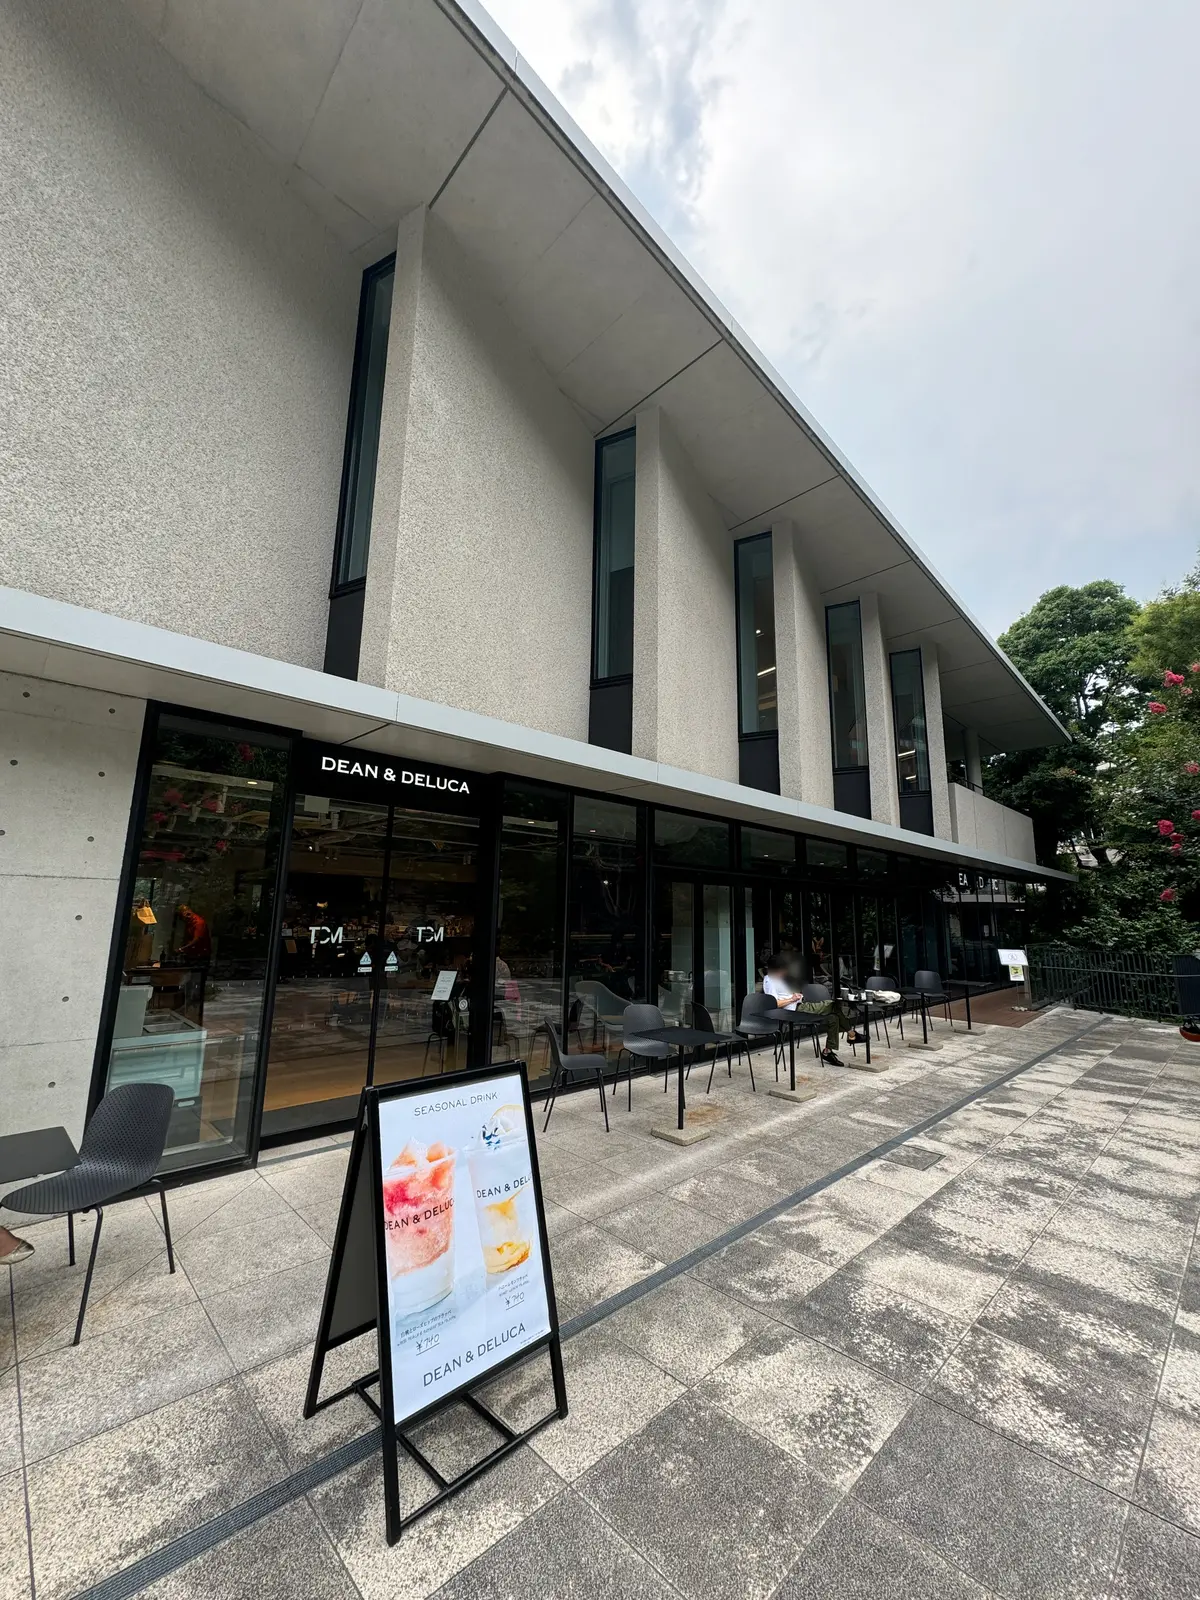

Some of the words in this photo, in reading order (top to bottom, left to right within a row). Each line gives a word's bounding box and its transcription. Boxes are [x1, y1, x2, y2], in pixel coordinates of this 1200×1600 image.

[321, 756, 379, 779] DEAN
[383, 767, 396, 782] &
[401, 770, 470, 794] DELUCA
[413, 1098, 467, 1117] SEASONAL
[470, 1091, 498, 1105] DRINK
[476, 1185, 501, 1199] DEAN
[504, 1182, 511, 1193] &
[412, 1214, 421, 1225] &
[415, 1333, 440, 1352] ¥740
[423, 1355, 462, 1388] DEAN
[465, 1350, 474, 1364] &
[477, 1322, 526, 1357] DELUCA
